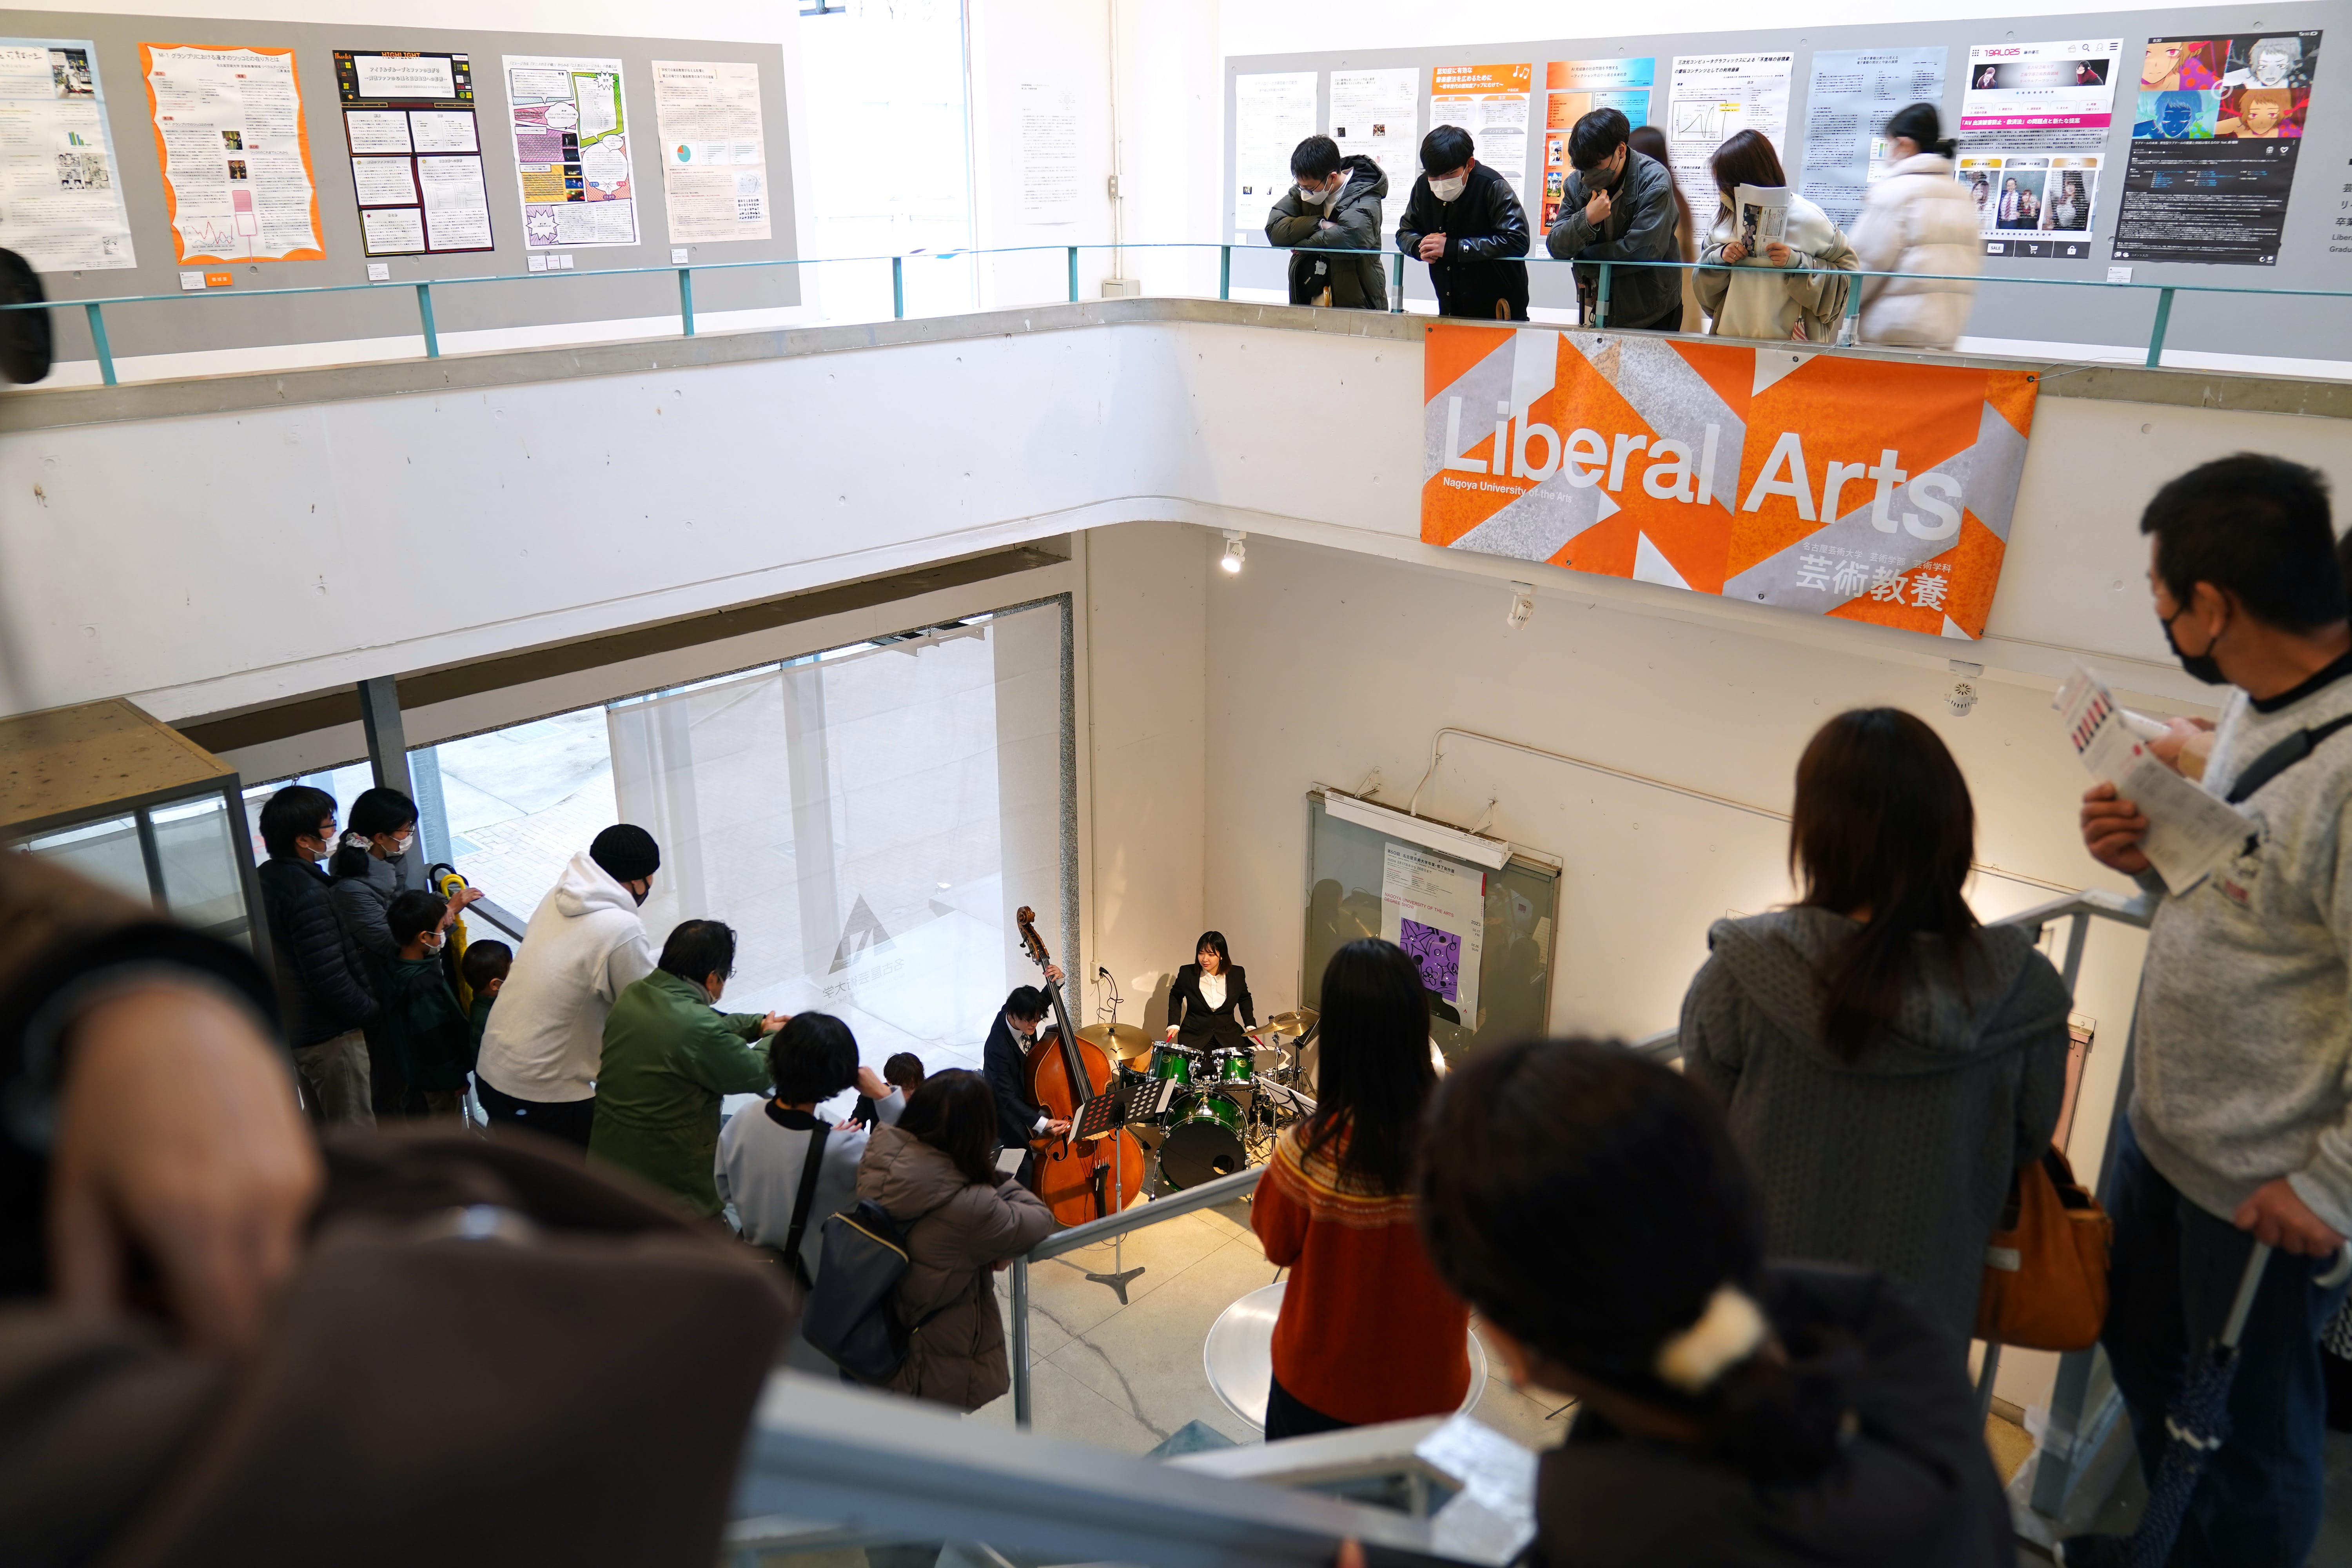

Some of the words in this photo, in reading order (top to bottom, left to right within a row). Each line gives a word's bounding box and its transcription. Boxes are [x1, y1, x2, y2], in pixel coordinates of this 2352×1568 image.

[1444, 396, 1720, 505] Liberal
[1742, 432, 1962, 541] Arts
[1443, 477, 1477, 490] Nagoya
[1480, 481, 1526, 496] University
[1541, 489, 1555, 499] the
[1557, 492, 1572, 503] Arts
[1803, 542, 1863, 559] 名古屋芸術大学
[1869, 553, 1906, 566] 芸術学部
[1913, 559, 1951, 573] 芸術学科
[1796, 554, 1948, 612] 芸術教養
[1385, 893, 1401, 901] NAGOYA
[1402, 898, 1427, 908] UNIVERSITY
[1385, 897, 1401, 905] DEGREE
